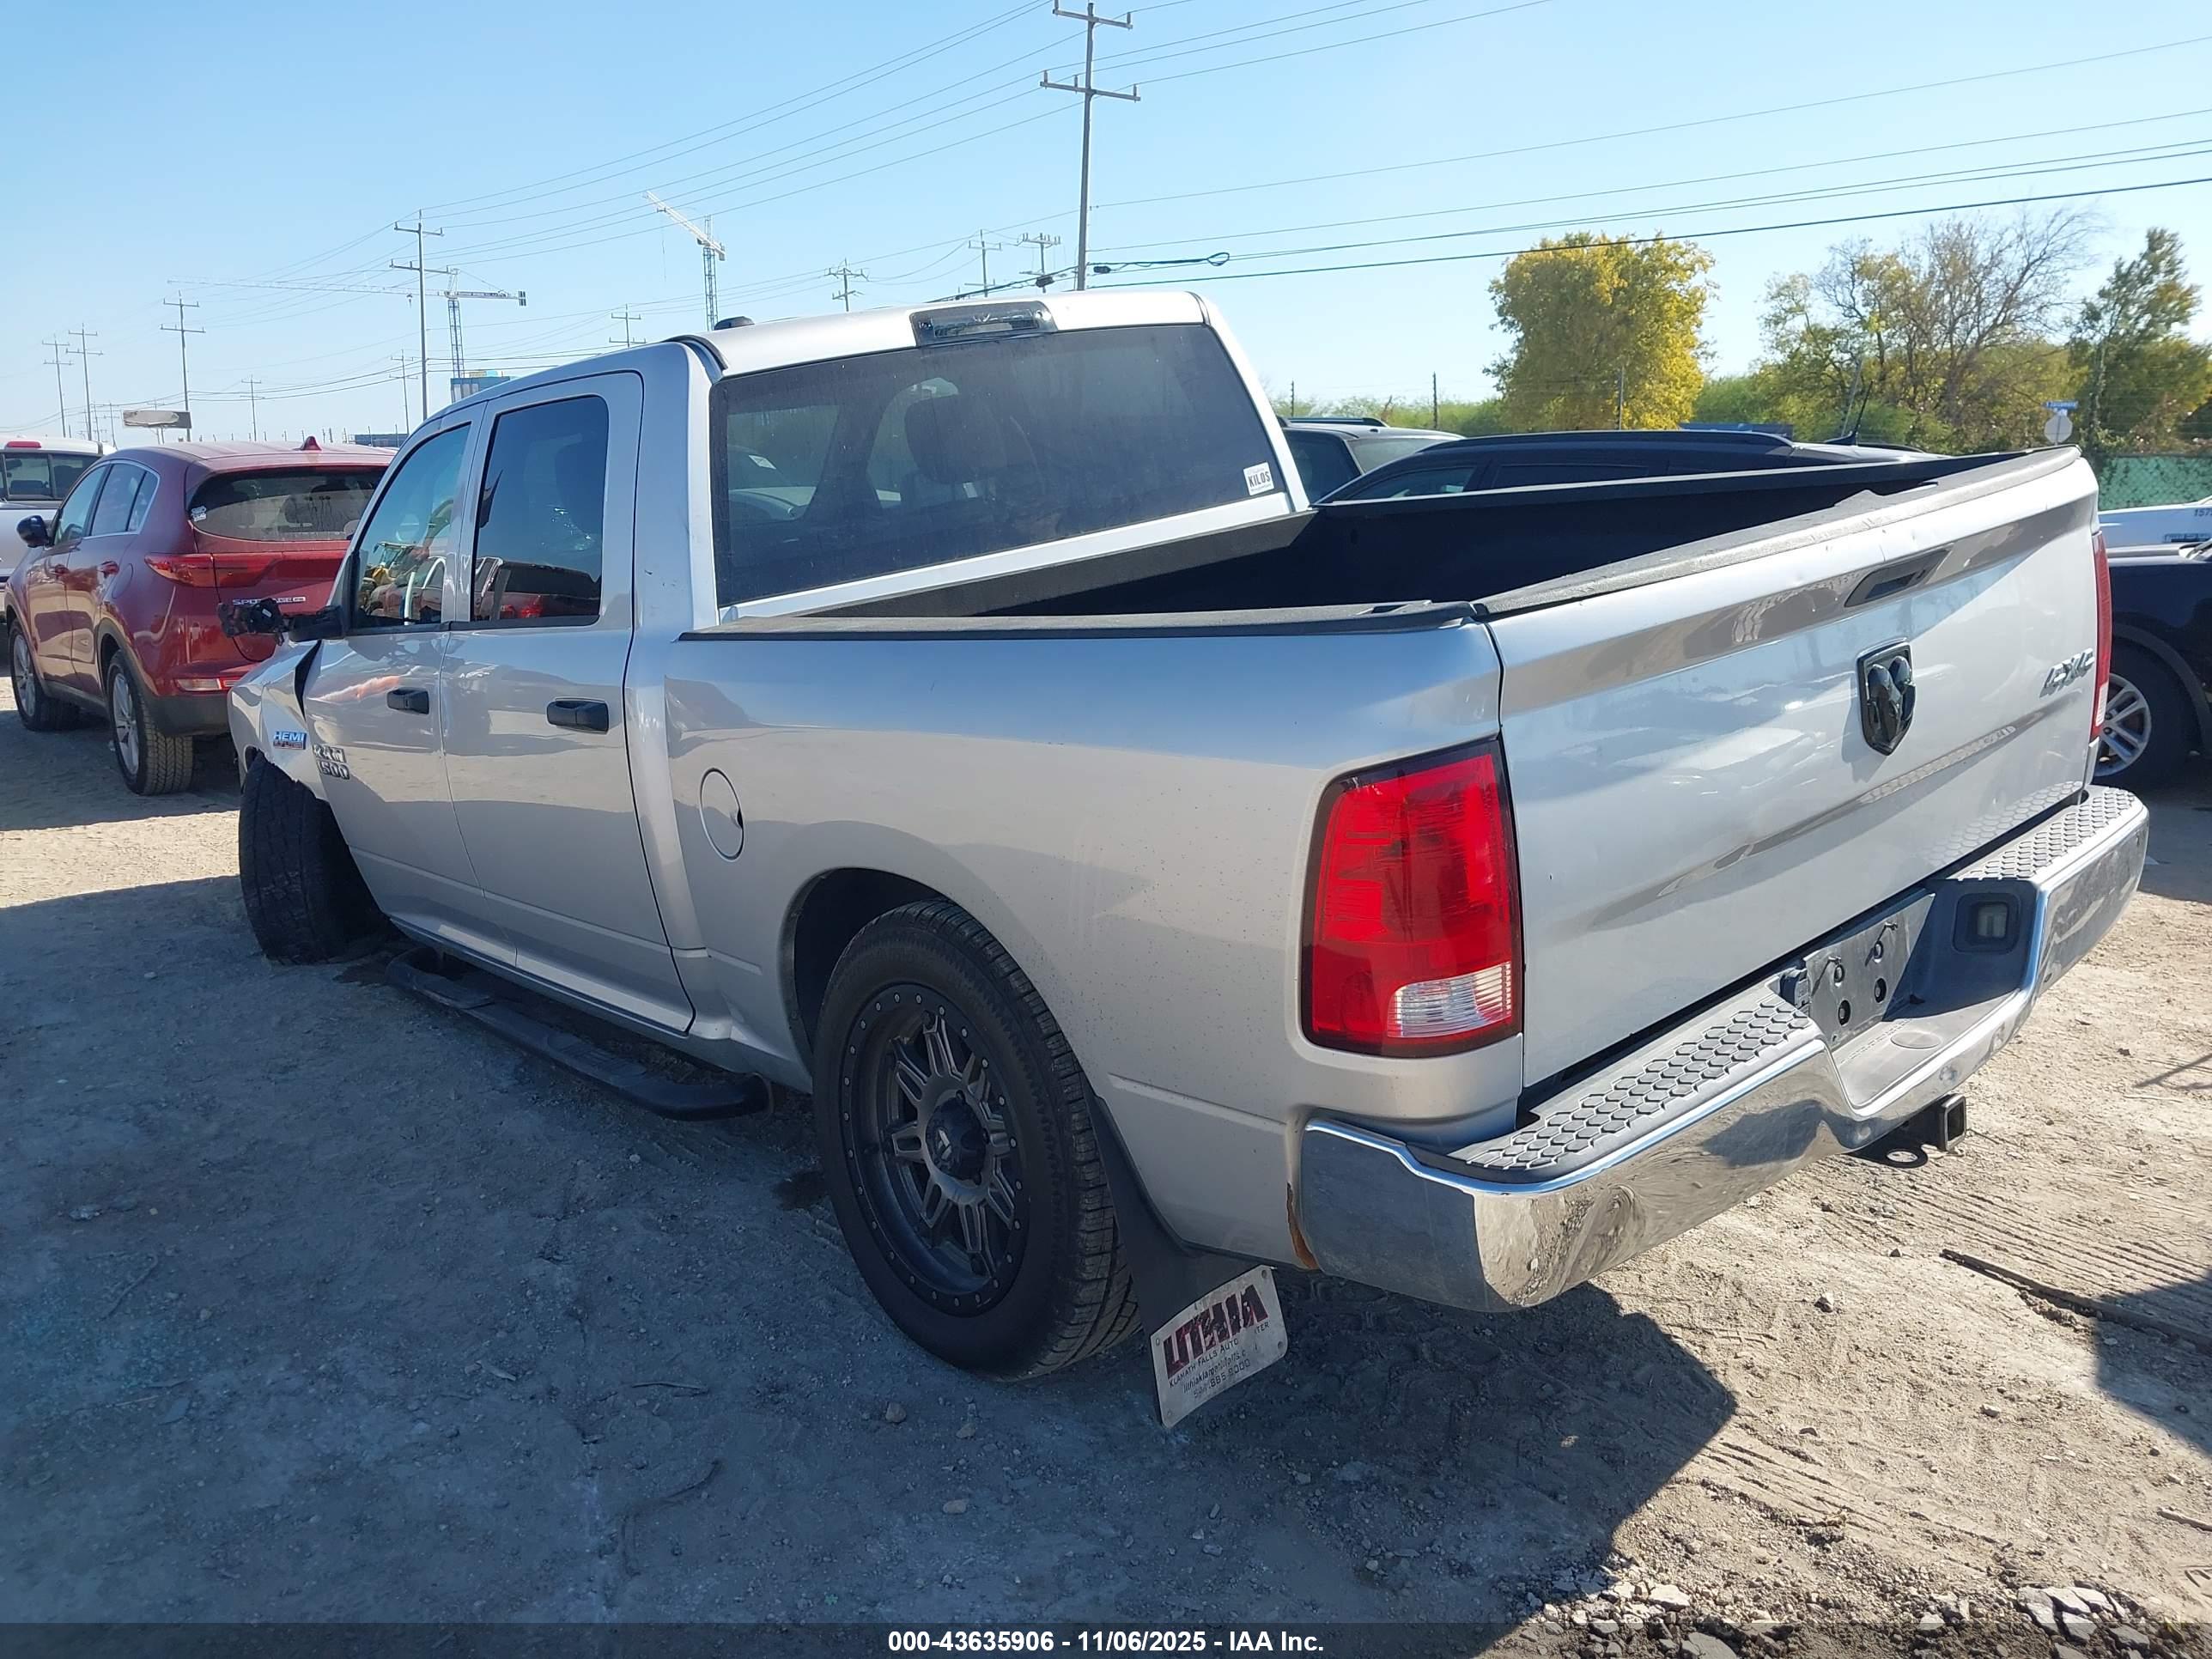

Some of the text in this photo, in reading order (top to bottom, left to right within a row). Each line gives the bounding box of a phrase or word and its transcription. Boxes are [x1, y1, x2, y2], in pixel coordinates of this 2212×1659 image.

[1248, 471, 1271, 488] KILOS
[273, 731, 305, 742] HEMI
[312, 744, 347, 763] RAM
[316, 759, 350, 780] 1500
[1163, 1285, 1268, 1379] LITHIA
[1169, 1364, 1196, 1388] KLAMATH
[1197, 1350, 1218, 1367] FALLS
[1219, 1338, 1239, 1353] AUTO
